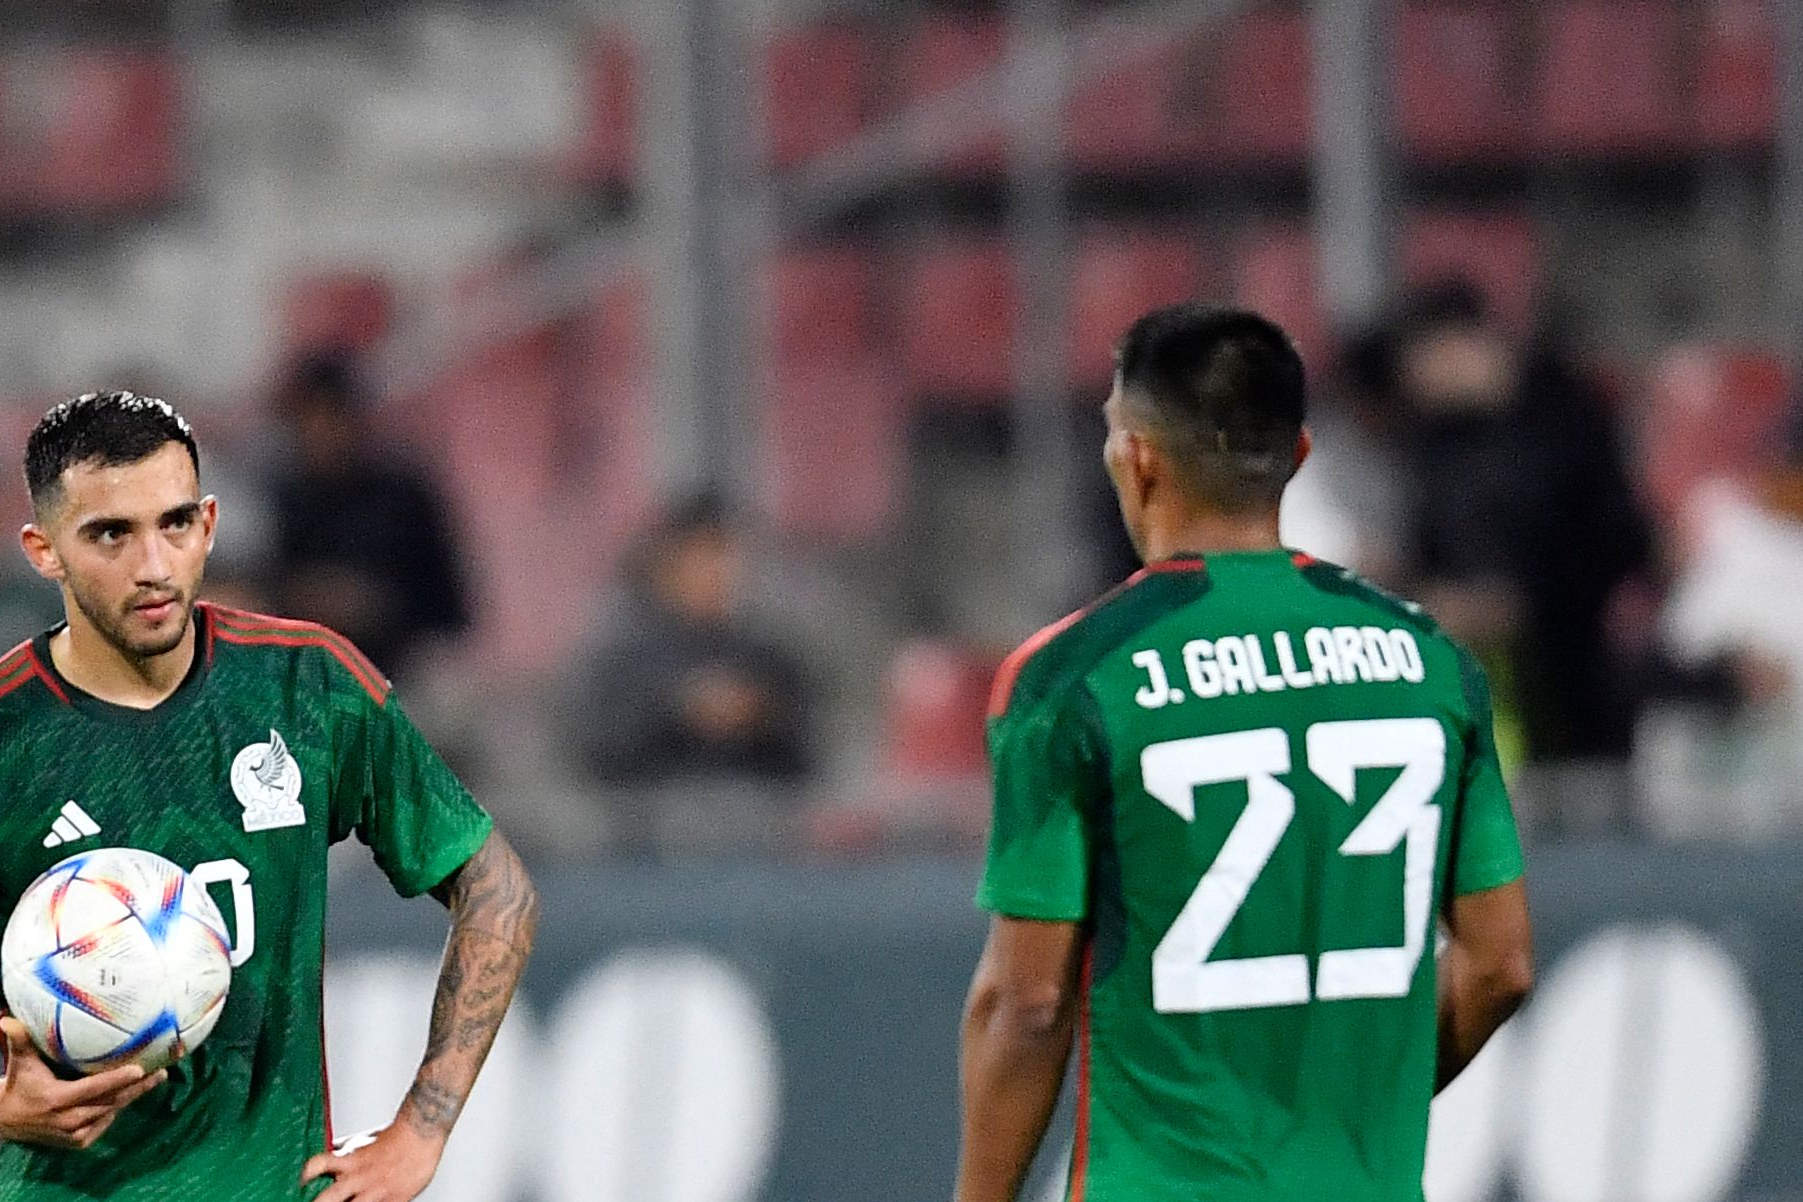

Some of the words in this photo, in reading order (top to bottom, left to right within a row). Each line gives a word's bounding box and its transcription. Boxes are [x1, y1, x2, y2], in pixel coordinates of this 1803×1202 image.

[1132, 648, 1185, 708] J.
[1182, 626, 1425, 699] GALLARDO
[1140, 717, 1446, 1014] 23
